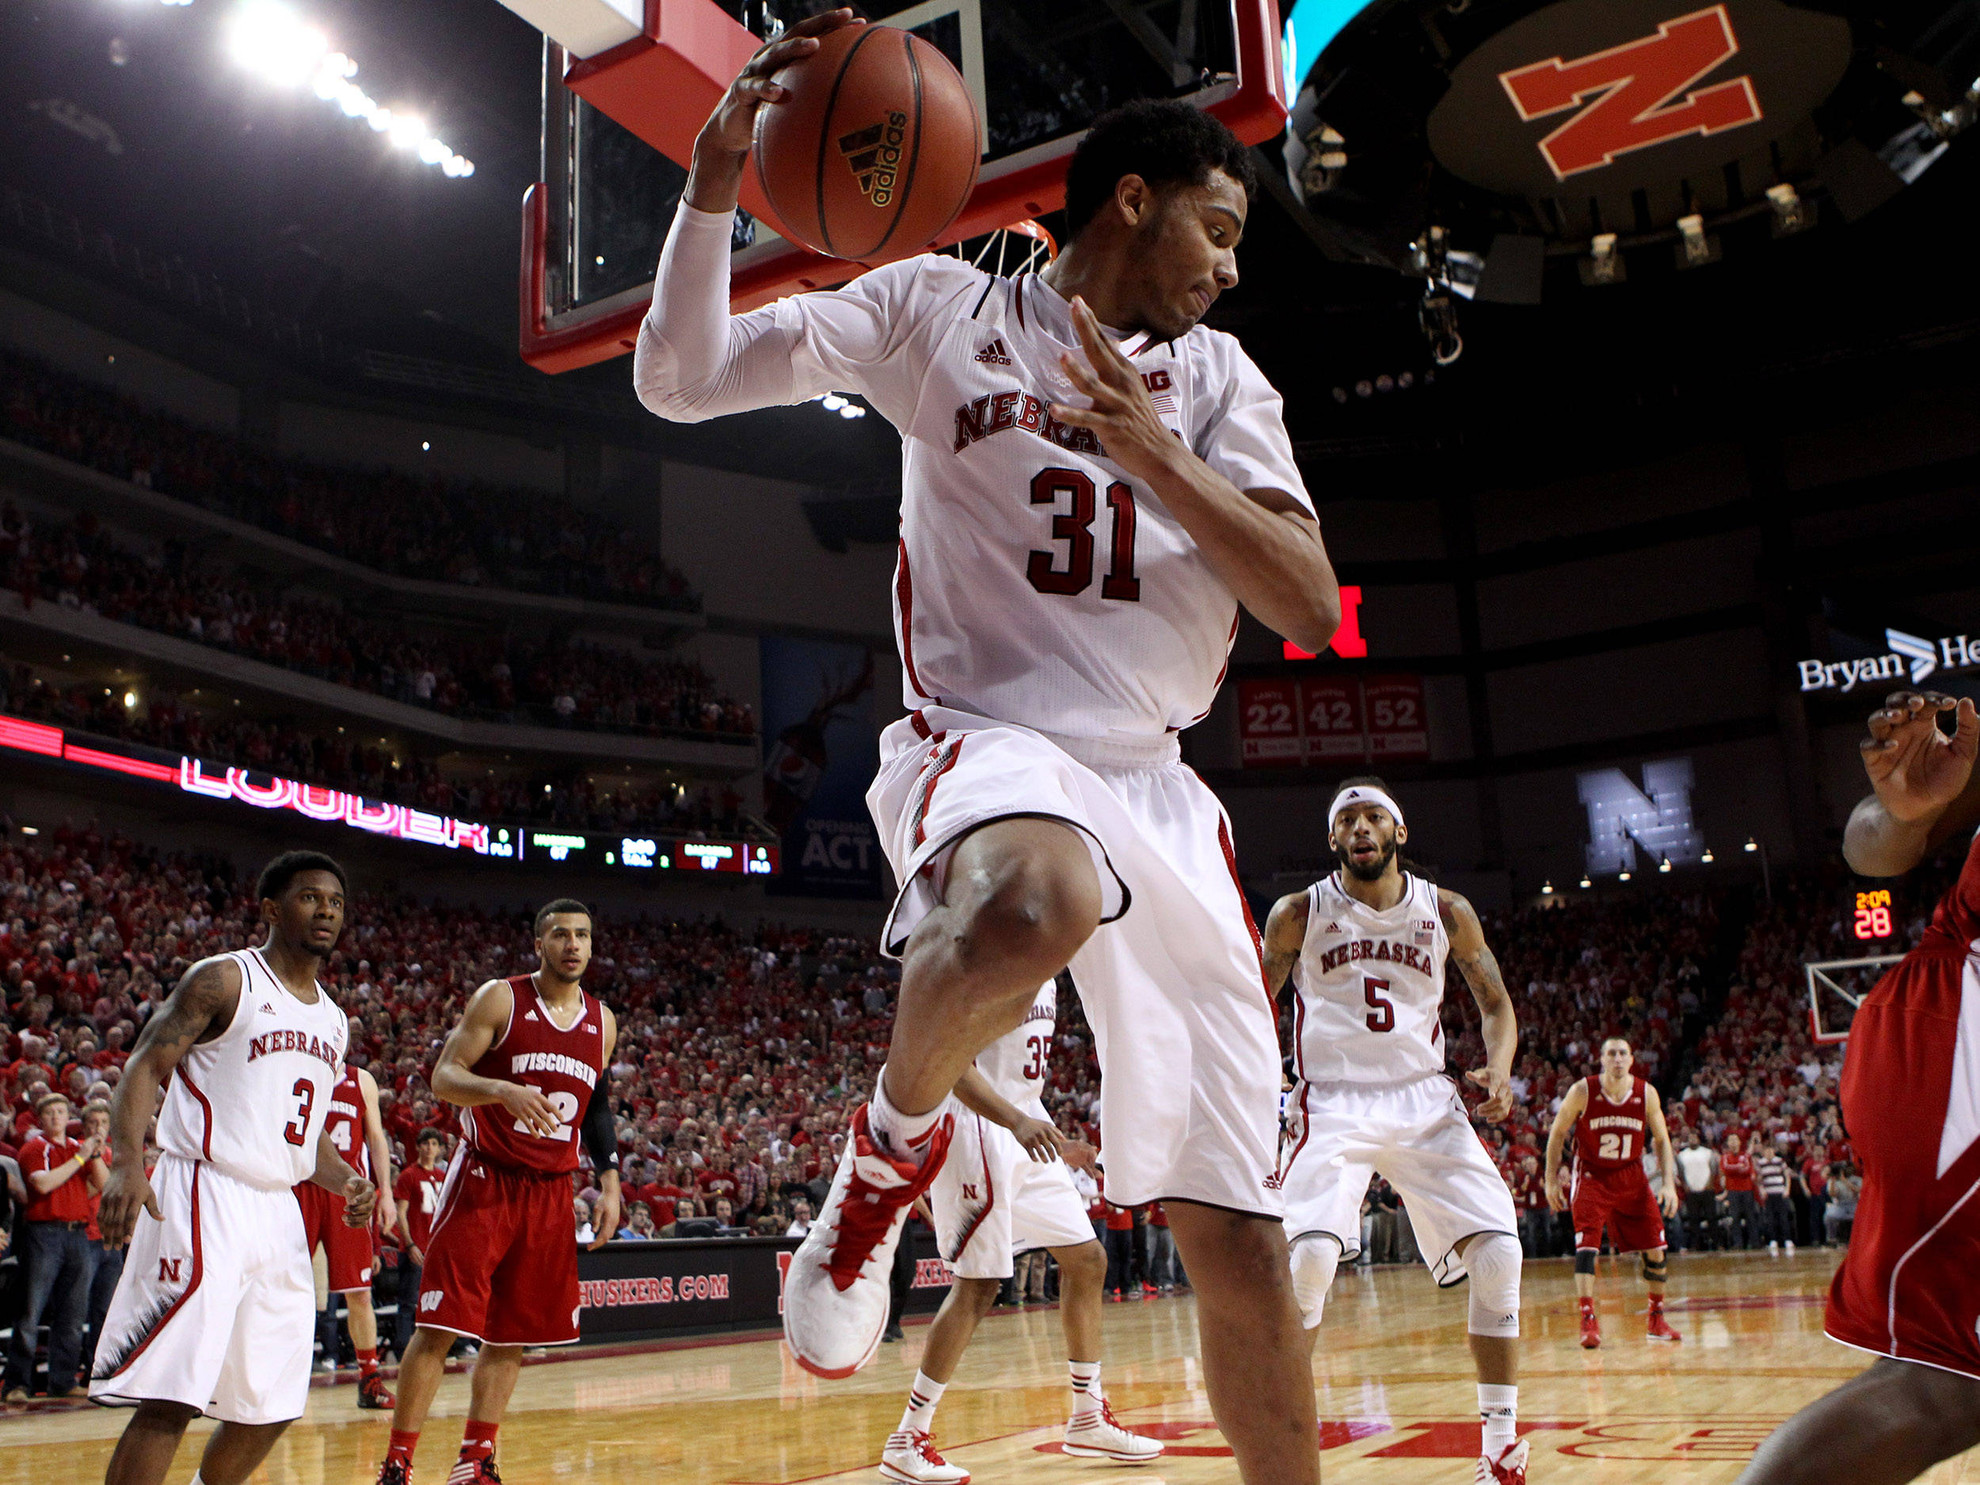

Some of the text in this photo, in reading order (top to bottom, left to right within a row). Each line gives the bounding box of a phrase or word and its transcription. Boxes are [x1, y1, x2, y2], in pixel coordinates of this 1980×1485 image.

[1499, 3, 1762, 181] N
[871, 110, 908, 208] adidas
[974, 353, 1012, 366] adidas
[954, 388, 1183, 457] NEBRA
[1026, 466, 1141, 603] 31
[1797, 653, 1905, 693] Bryan
[1246, 703, 1293, 733] 22
[1309, 701, 1354, 731] 42
[1374, 699, 1419, 727] 52
[180, 755, 490, 856] LOUDER
[1576, 757, 1702, 874] N
[801, 832, 873, 871] ACT
[1856, 889, 1891, 910] 2:09
[1854, 907, 1892, 939] 28
[1320, 939, 1433, 978] NEBRASKA
[1364, 977, 1395, 1032] 5
[511, 1052, 598, 1091] WISCONSIN
[283, 1077, 315, 1147] 3
[1589, 1115, 1643, 1132] WISCONSIN
[1598, 1133, 1633, 1160] 21
[962, 1184, 978, 1200] N
[159, 1258, 181, 1282] N
[578, 1274, 730, 1309] HUSKERS.COM
